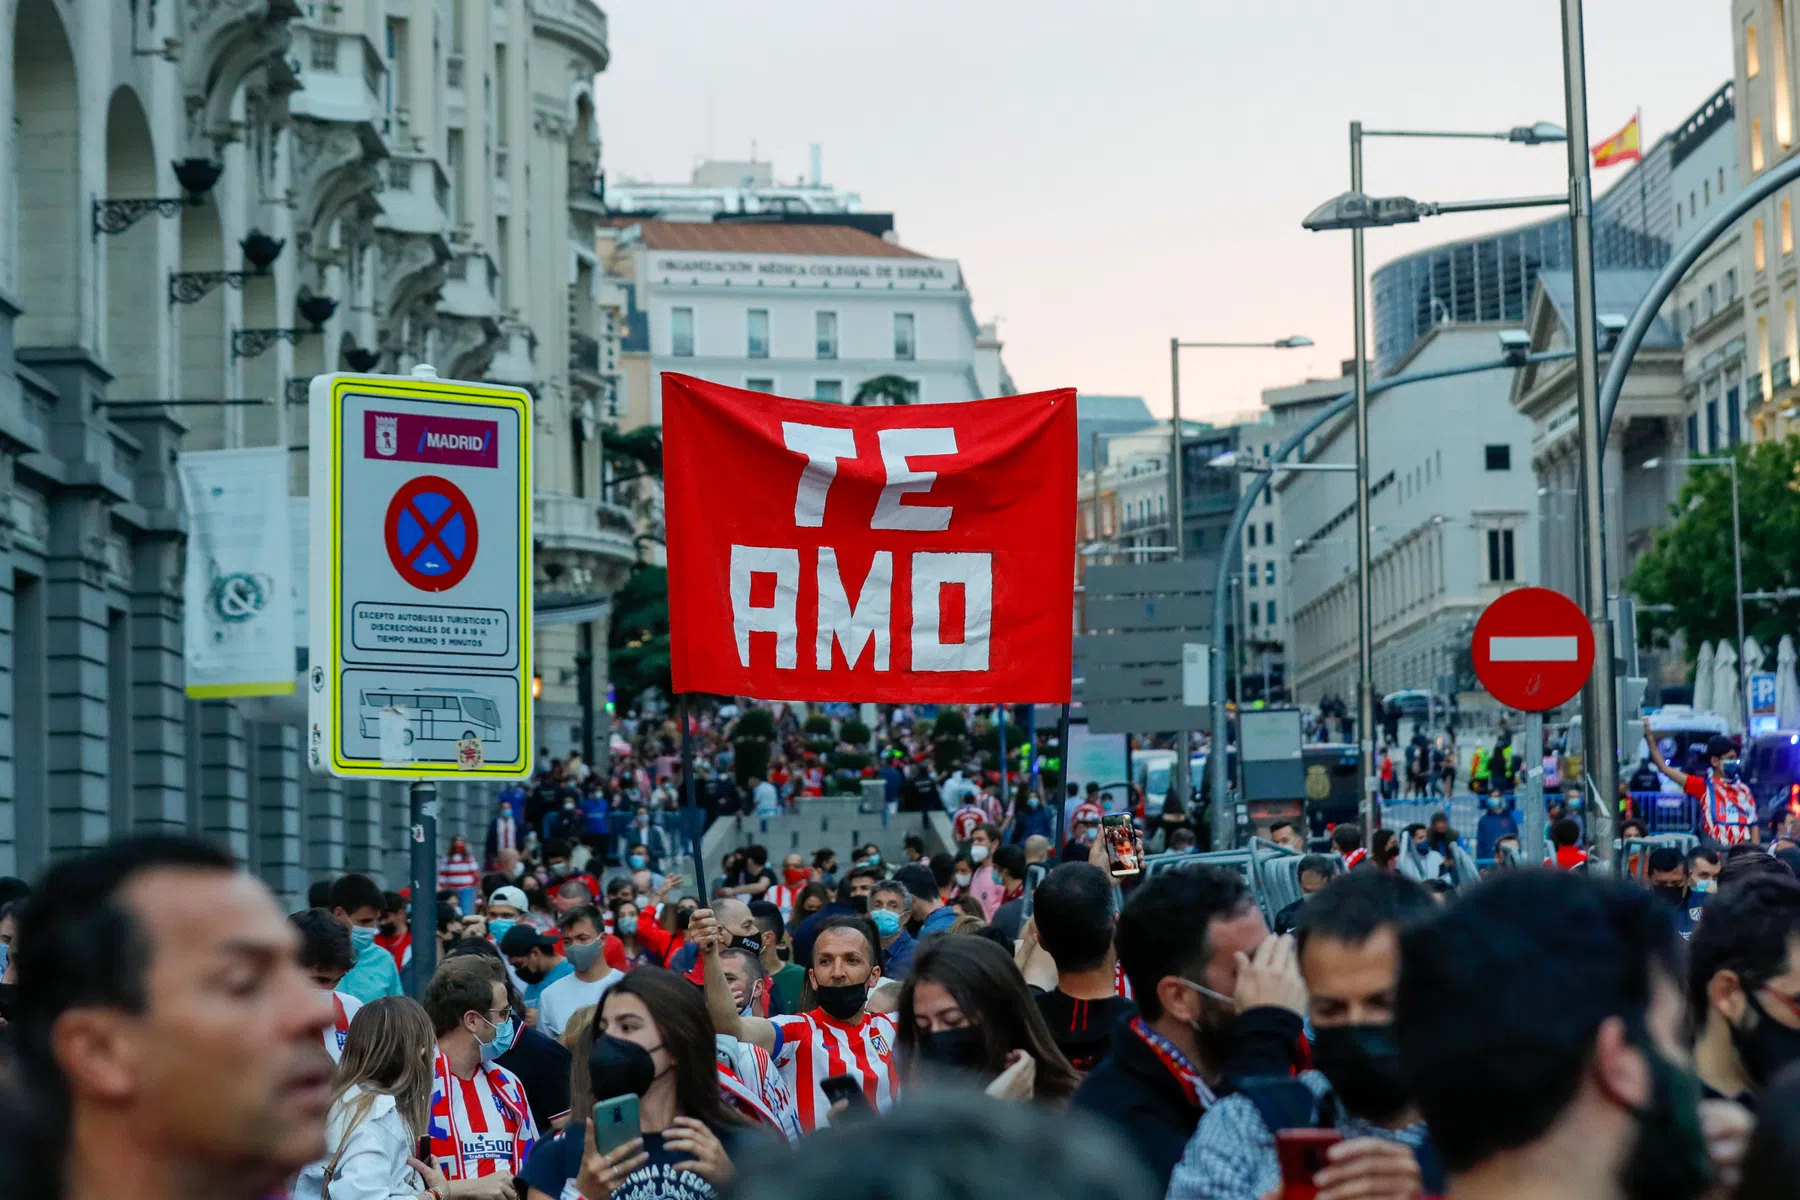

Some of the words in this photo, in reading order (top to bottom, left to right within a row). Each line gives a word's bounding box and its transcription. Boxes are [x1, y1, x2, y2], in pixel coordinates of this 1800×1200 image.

[781, 421, 958, 531] TE
[729, 543, 993, 672] AMO
[359, 611, 394, 620] EXCEPTO
[398, 614, 443, 623] AUTOBUSES
[447, 616, 492, 625] TURISTICOS
[494, 618, 499, 626] Y
[371, 623, 438, 634] DISCRECIONALES
[441, 626, 451, 634] DE
[376, 635, 404, 644] TIEMPO
[408, 636, 438, 645] MAXIMO
[441, 638, 446, 646] 5
[449, 639, 483, 647] MINUTOS
[1758, 679, 1774, 703] P
[741, 937, 760, 950] PUTO
